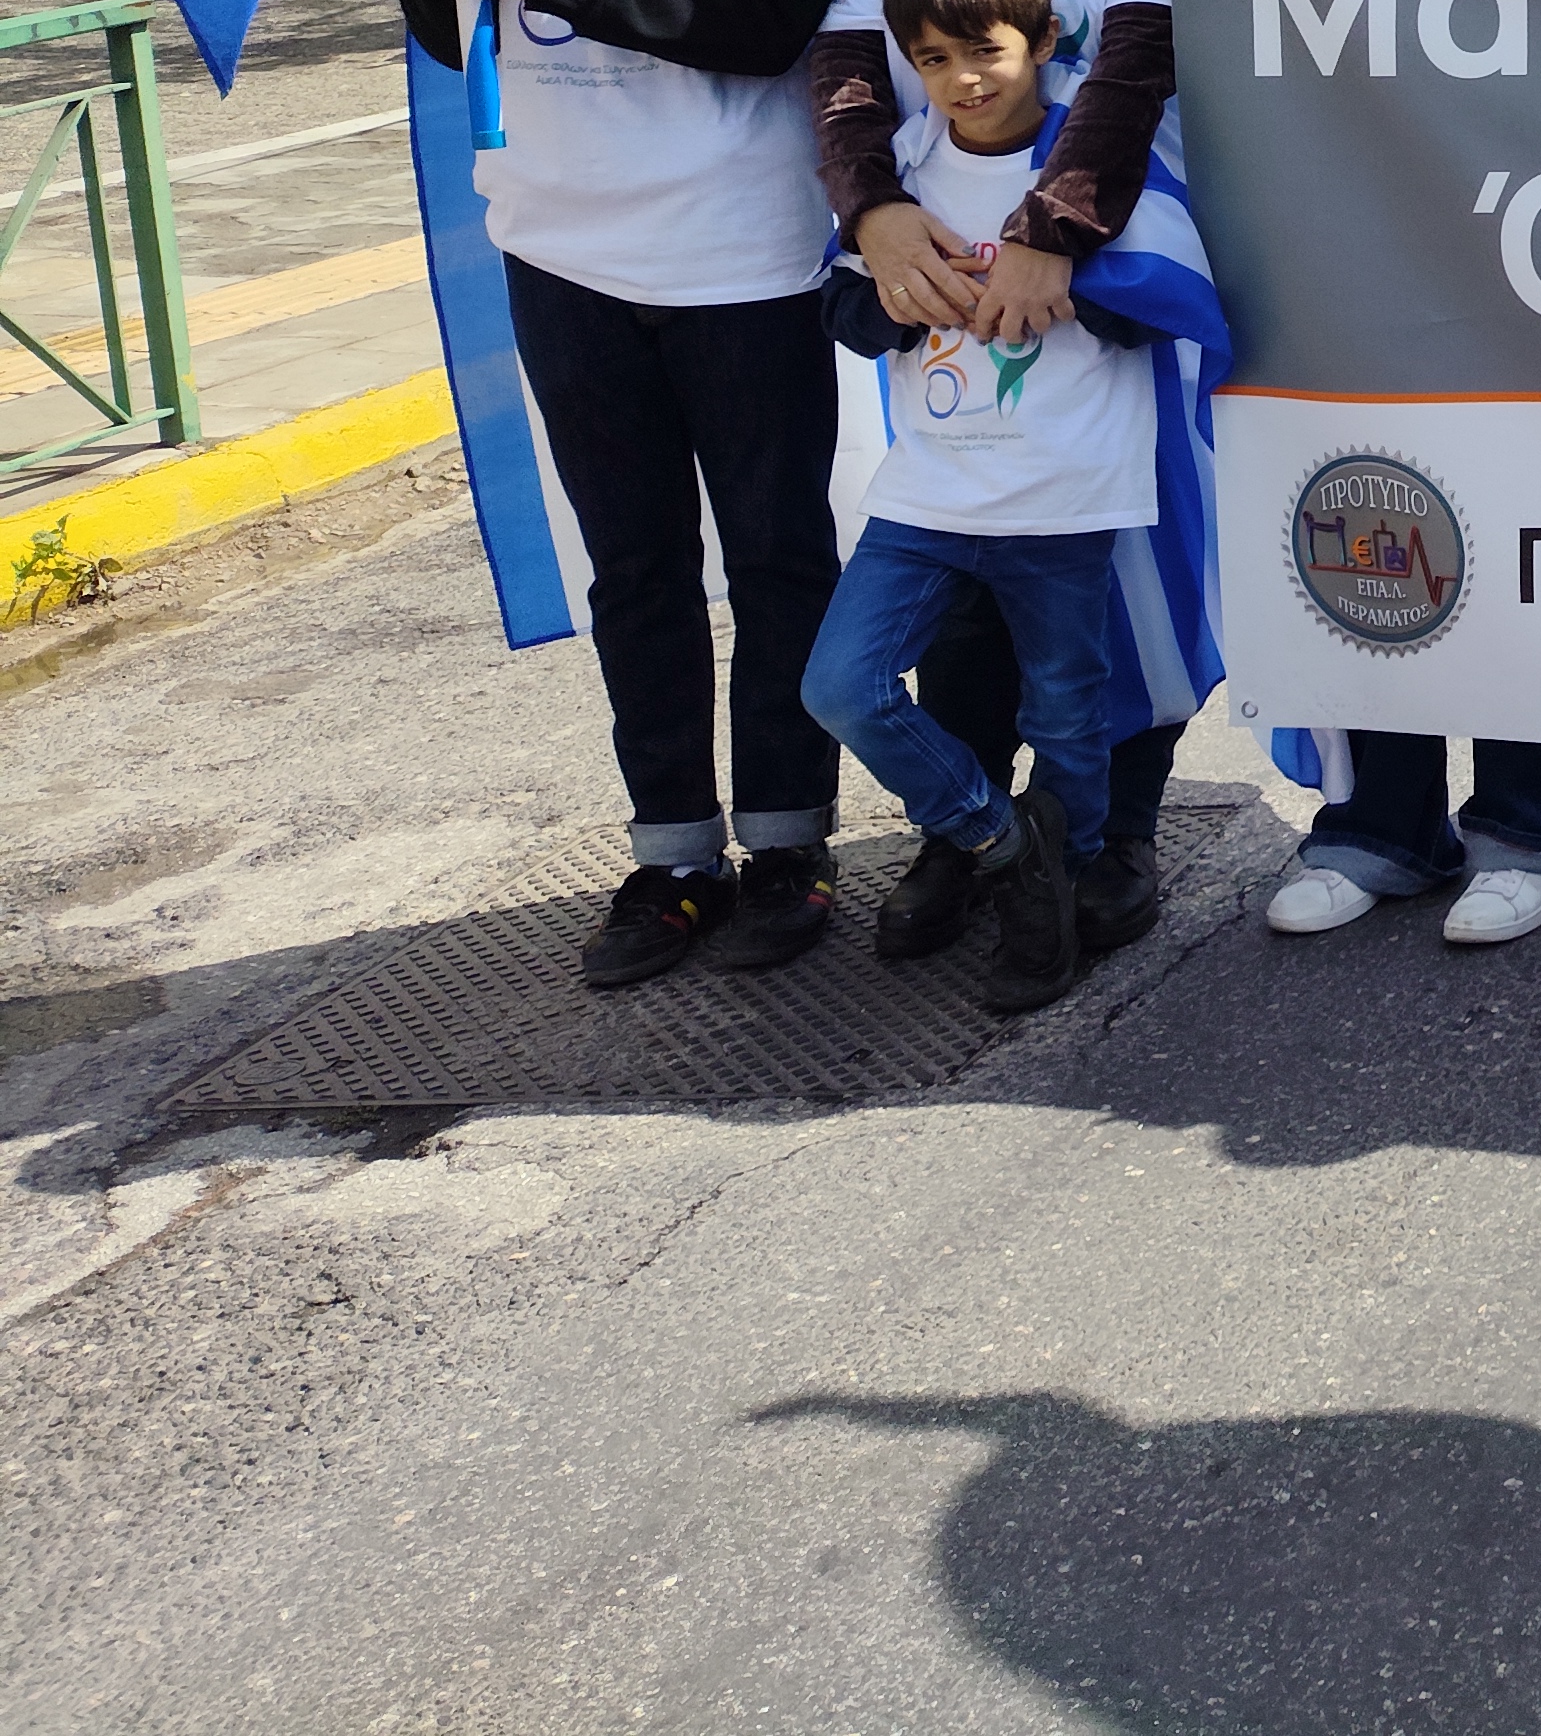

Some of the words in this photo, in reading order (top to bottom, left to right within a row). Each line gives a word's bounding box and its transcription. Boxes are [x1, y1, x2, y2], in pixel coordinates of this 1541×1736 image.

[1320, 474, 1429, 517] ΠΡΟΤΥΠΟ
[1356, 577, 1407, 600] ΕΠΑ.Λ.
[1337, 595, 1431, 628] ΠΕΡΑΜΑΤΟΣ
